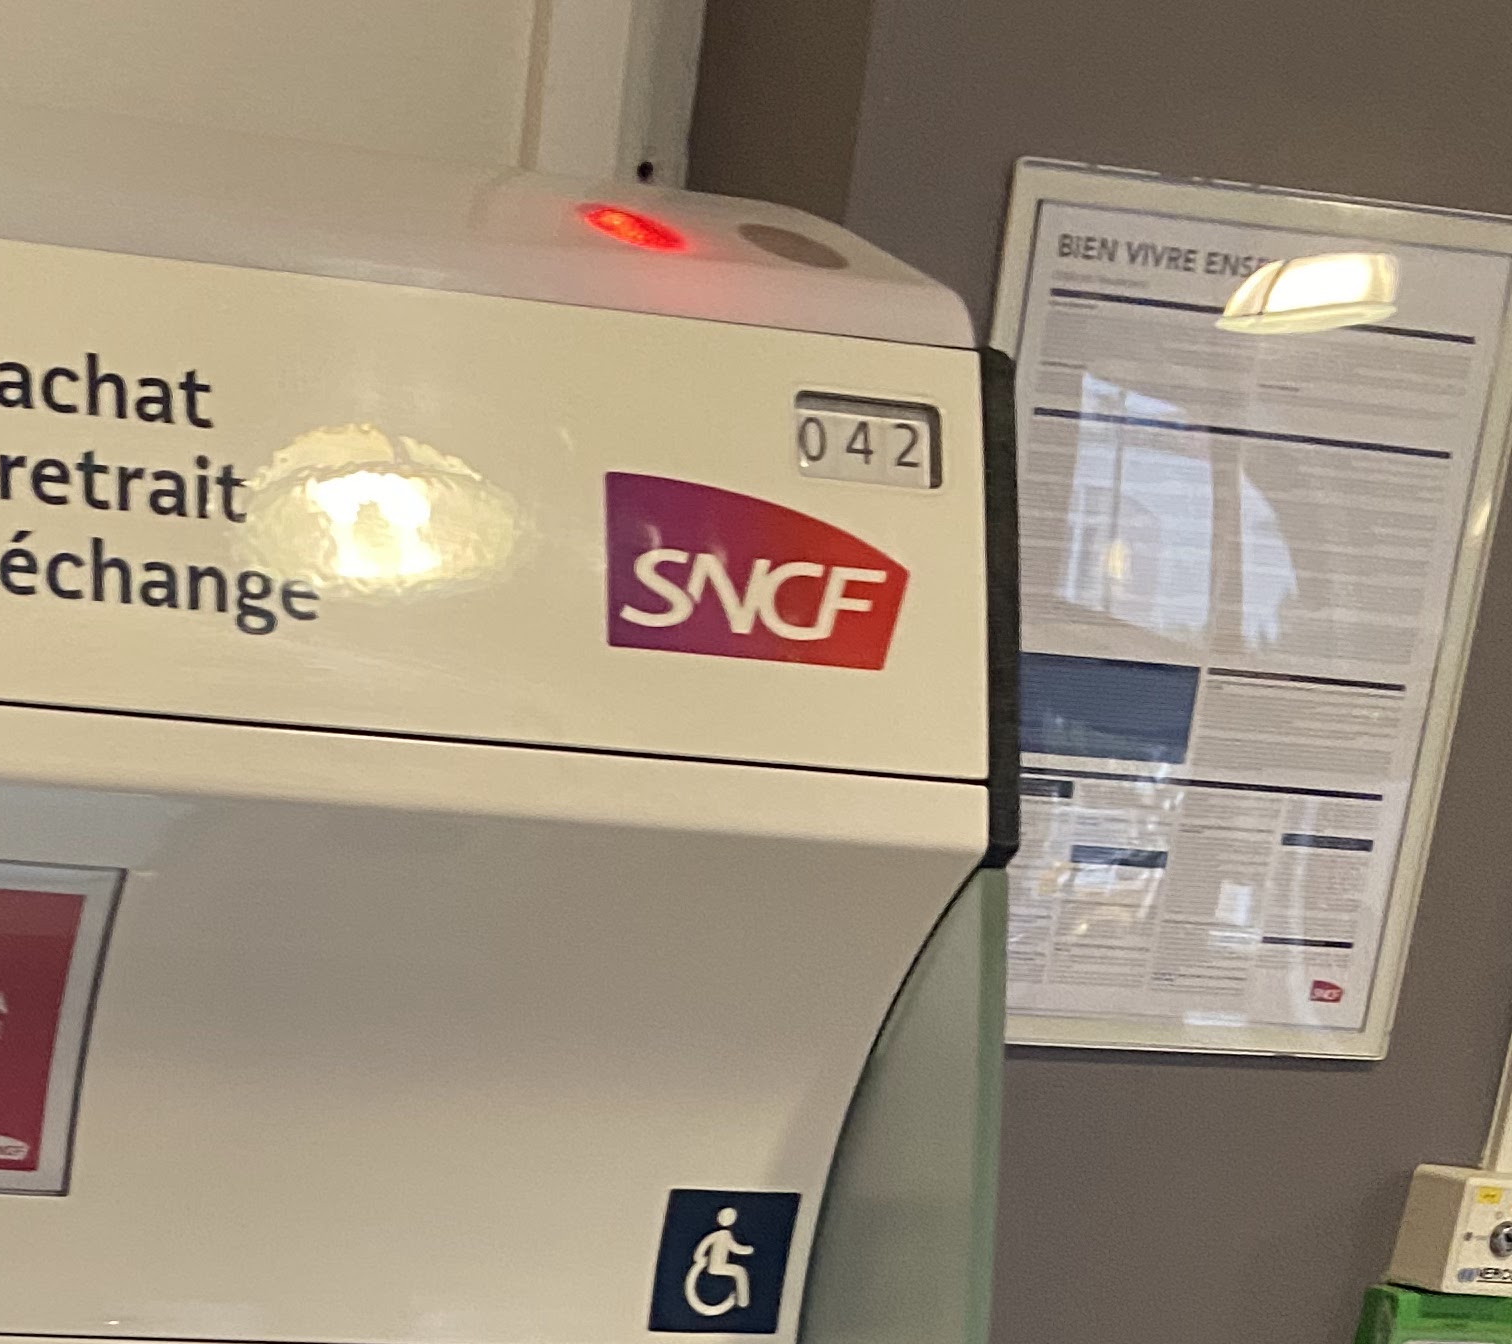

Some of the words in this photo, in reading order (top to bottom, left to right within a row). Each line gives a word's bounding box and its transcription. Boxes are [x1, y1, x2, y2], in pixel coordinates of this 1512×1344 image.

[1057, 233, 1118, 262] BIEN
[1126, 241, 1197, 272] VIVRE
[798, 416, 920, 468] 042
[619, 548, 888, 640] SNCF
